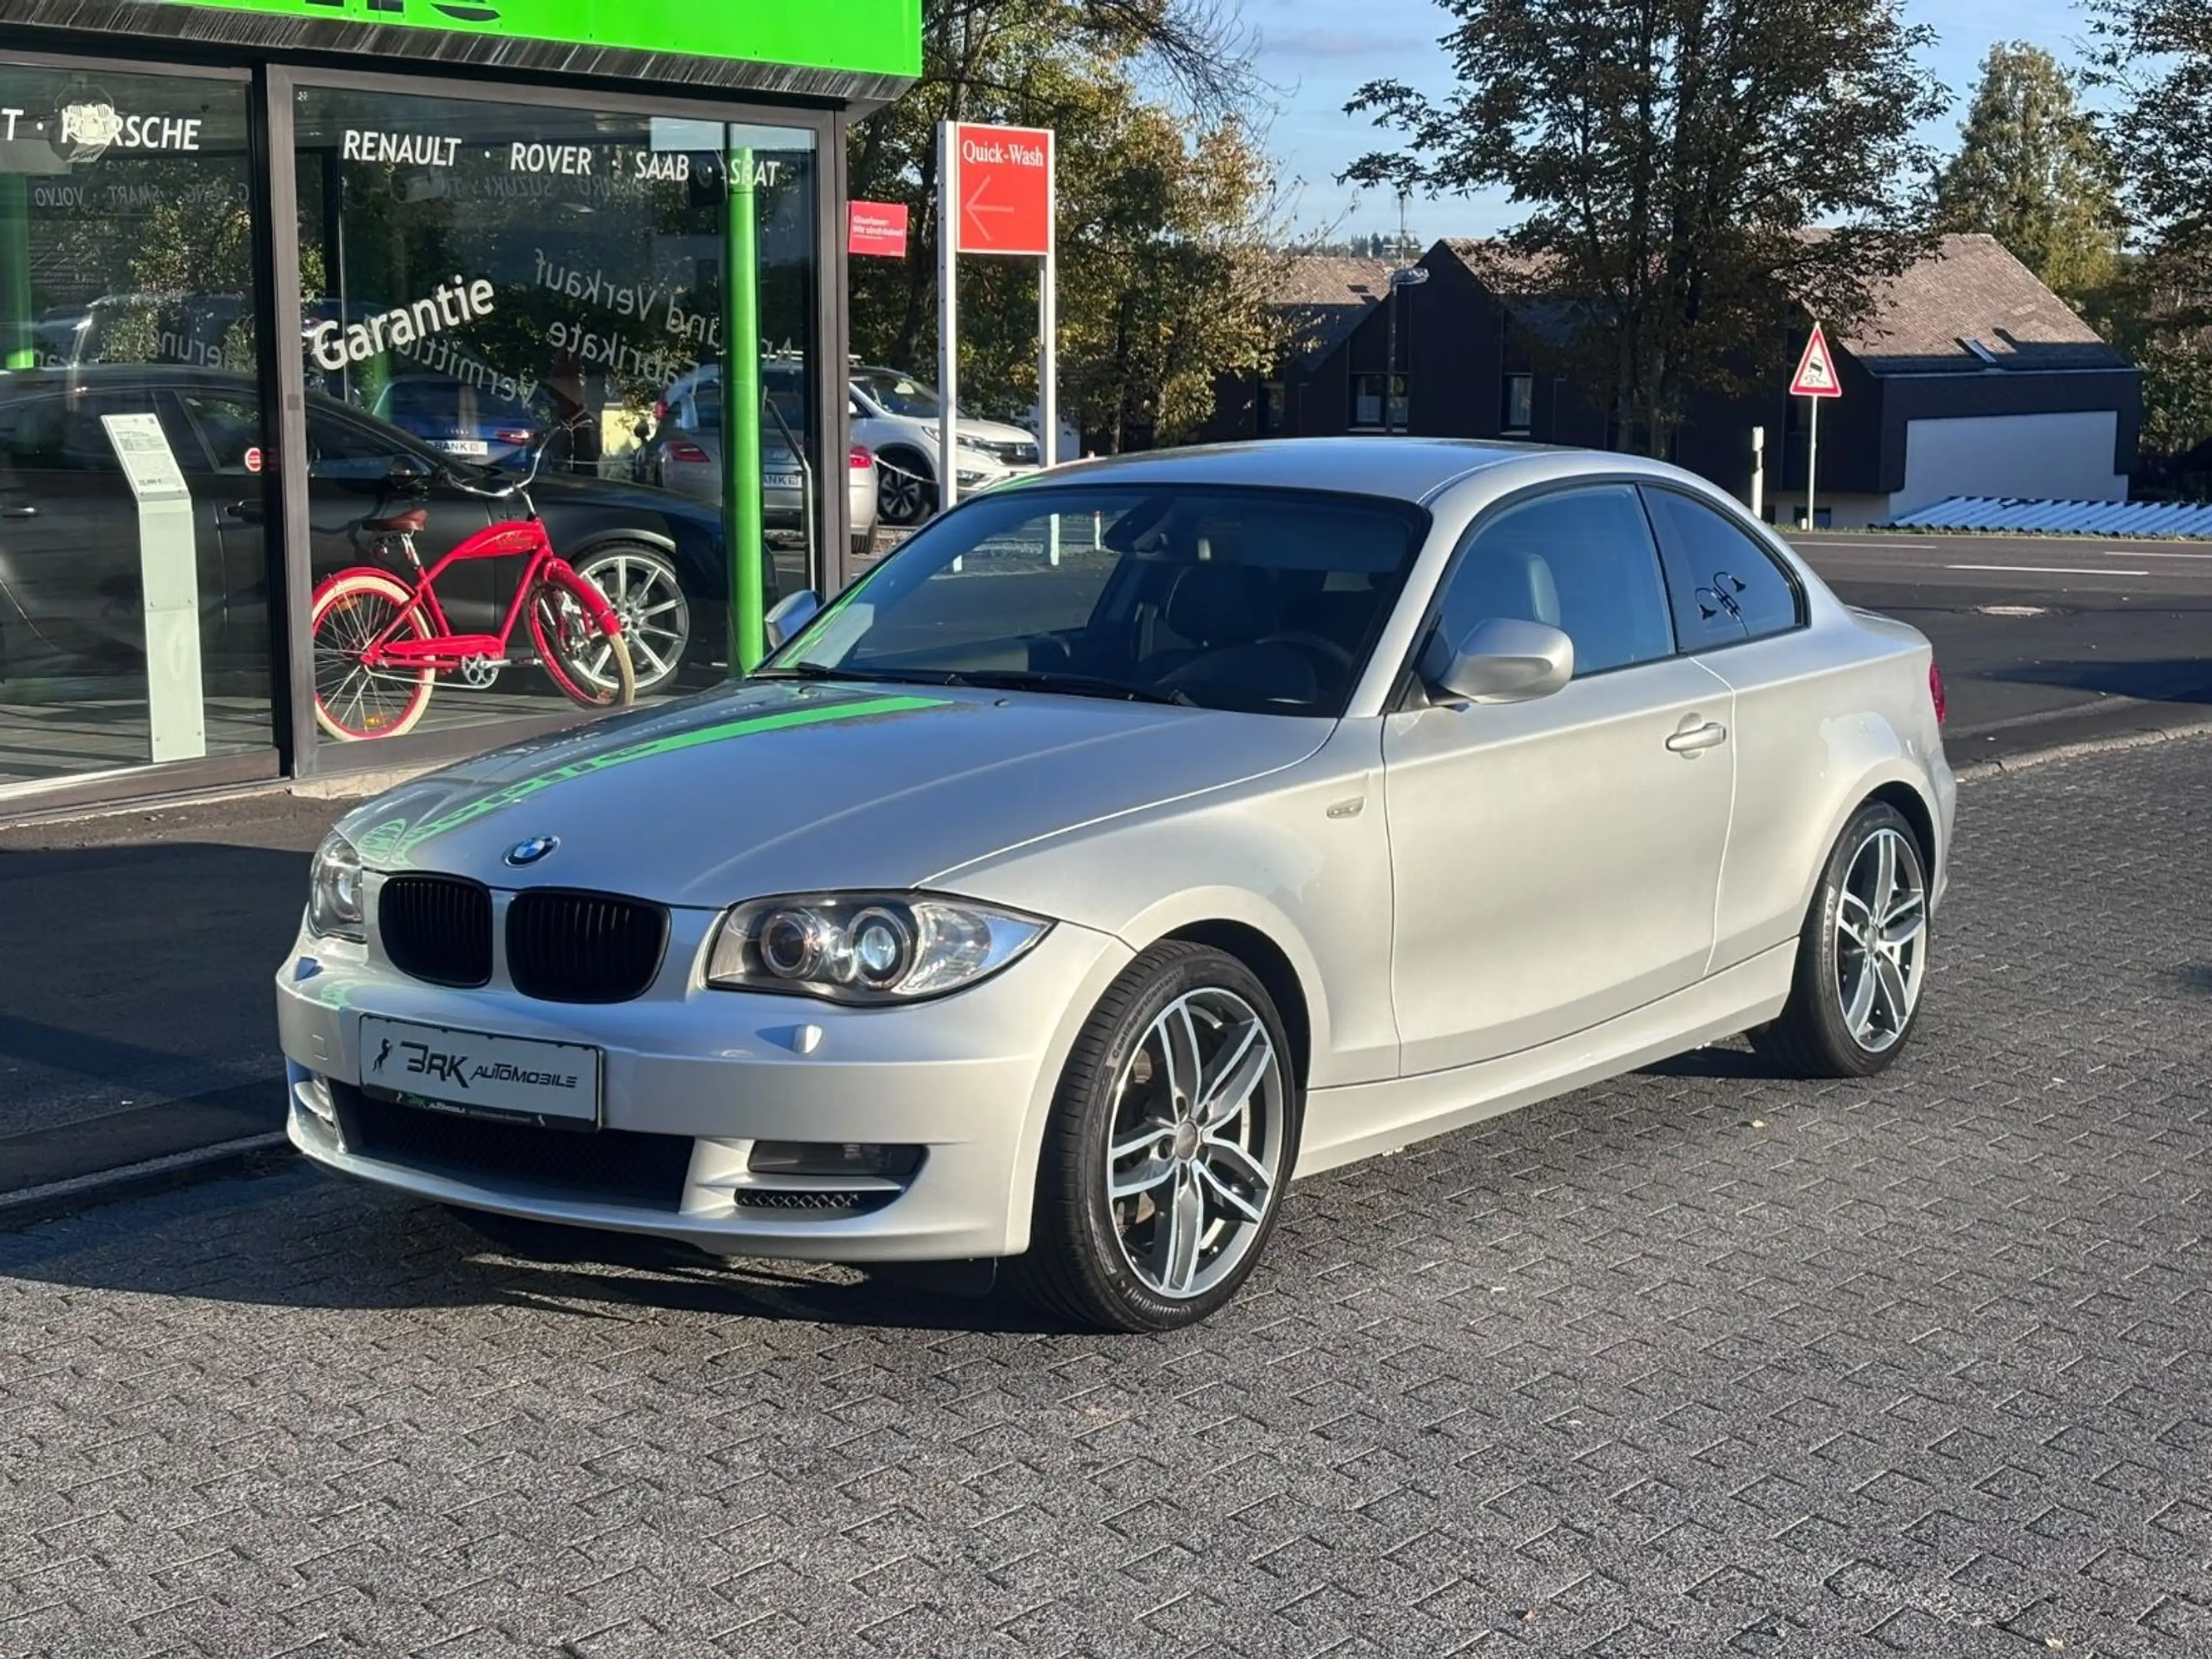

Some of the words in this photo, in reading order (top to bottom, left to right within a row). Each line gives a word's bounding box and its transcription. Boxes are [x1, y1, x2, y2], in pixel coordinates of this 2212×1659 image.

[61, 111, 202, 151] PRSCHE
[342, 129, 462, 166] RENAULT
[509, 142, 592, 175] ROVER
[634, 151, 689, 181] SAAB
[962, 139, 1044, 167] Quick-Wash
[311, 274, 494, 370] Garantie
[470, 1062, 578, 1089] AUTOMOBILE
